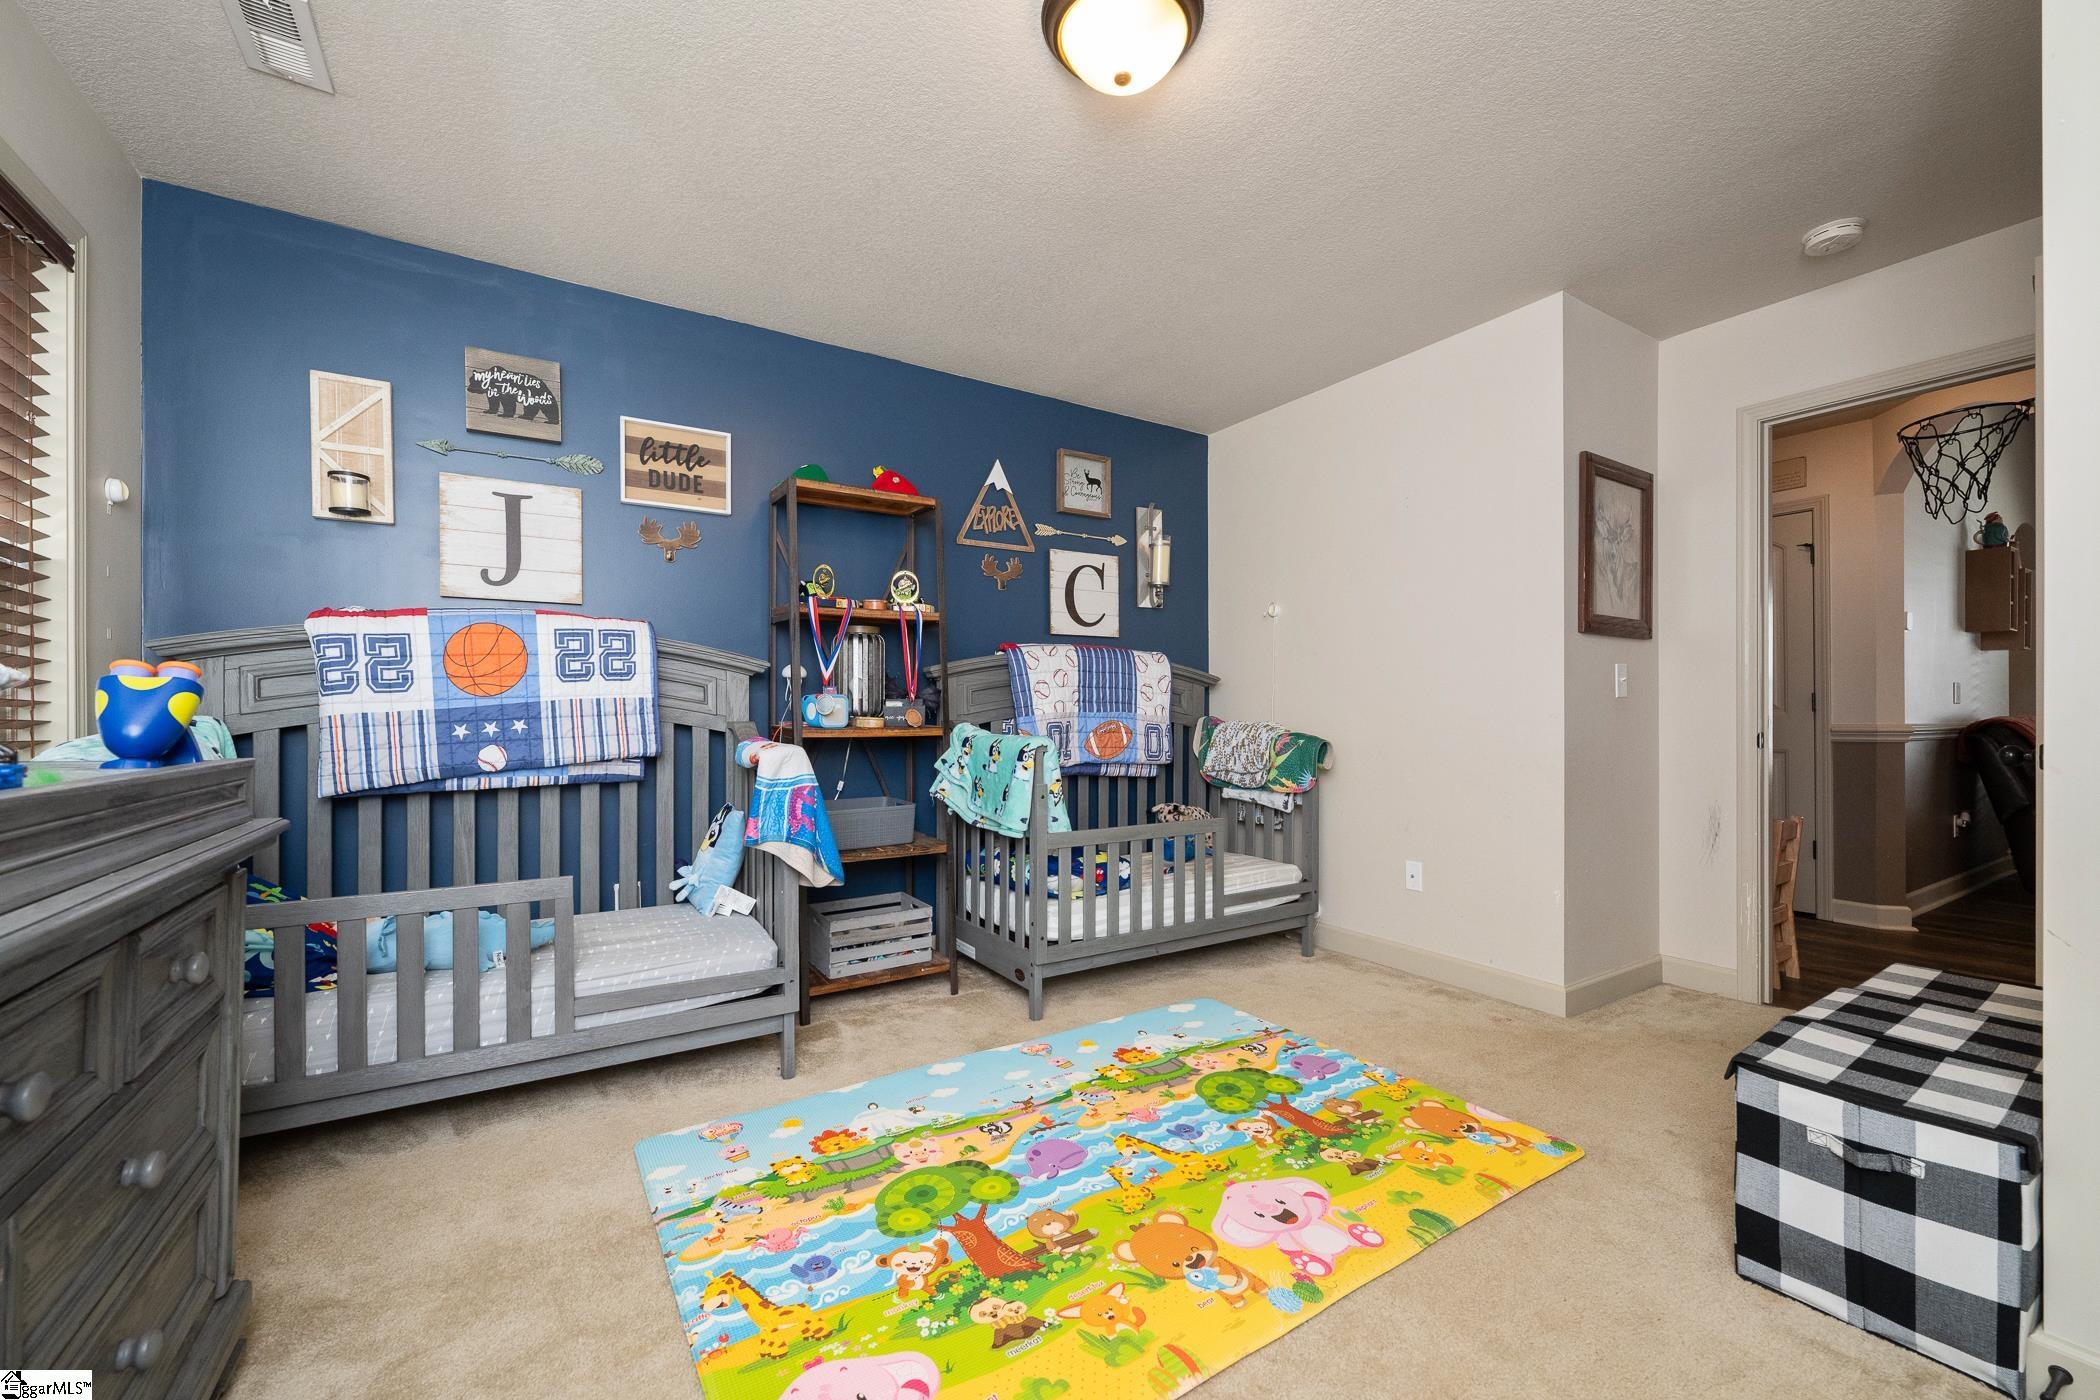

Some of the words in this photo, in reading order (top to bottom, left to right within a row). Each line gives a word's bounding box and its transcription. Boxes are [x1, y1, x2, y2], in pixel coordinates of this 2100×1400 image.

[639, 436, 711, 472] little
[648, 468, 704, 494] DUDE
[973, 504, 1020, 534] EXPLORE
[480, 491, 533, 587] J
[1064, 562, 1106, 628] C
[1006, 1335, 1043, 1358] meerkat
